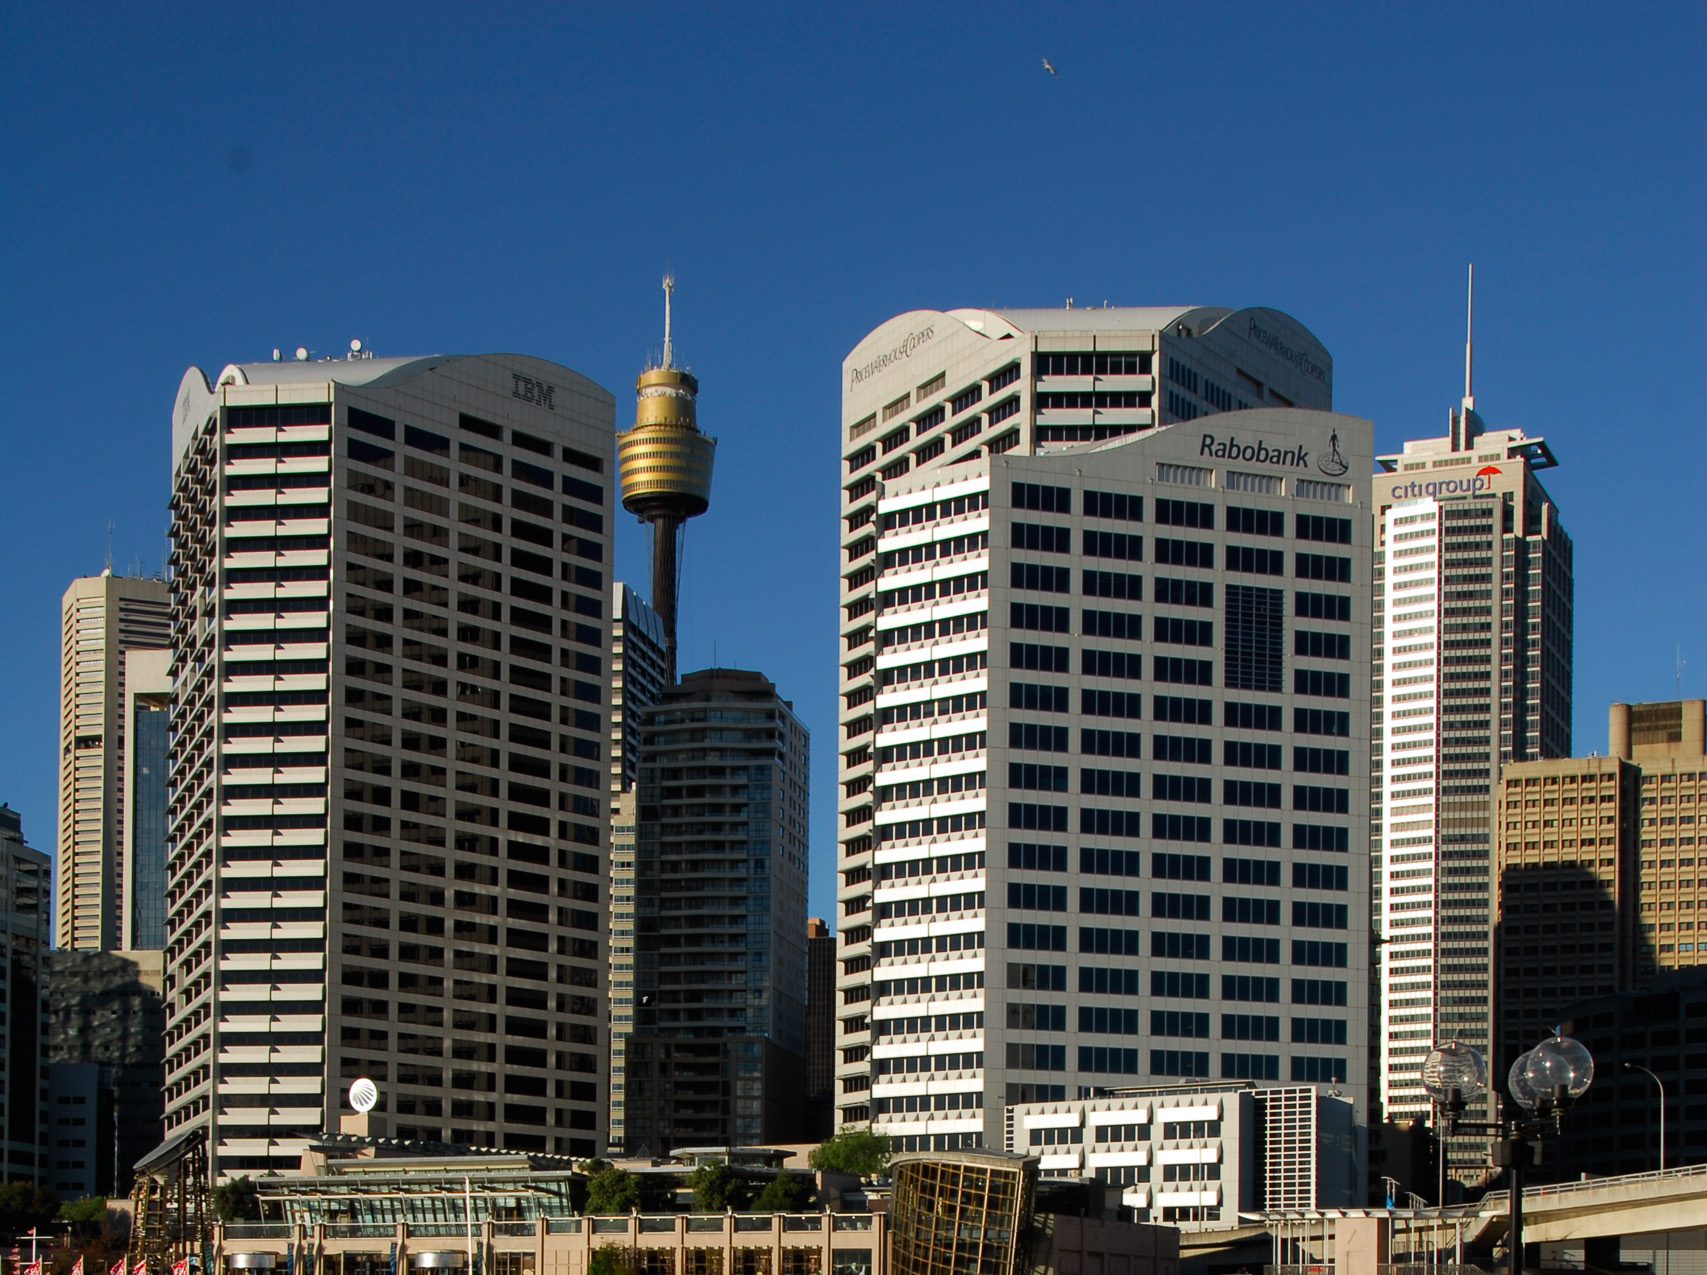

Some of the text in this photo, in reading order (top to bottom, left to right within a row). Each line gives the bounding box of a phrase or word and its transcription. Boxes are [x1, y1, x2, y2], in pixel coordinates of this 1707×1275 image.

[512, 372, 555, 411] IBM
[1199, 433, 1310, 469] Rabobank
[1391, 476, 1485, 499] citigroup
